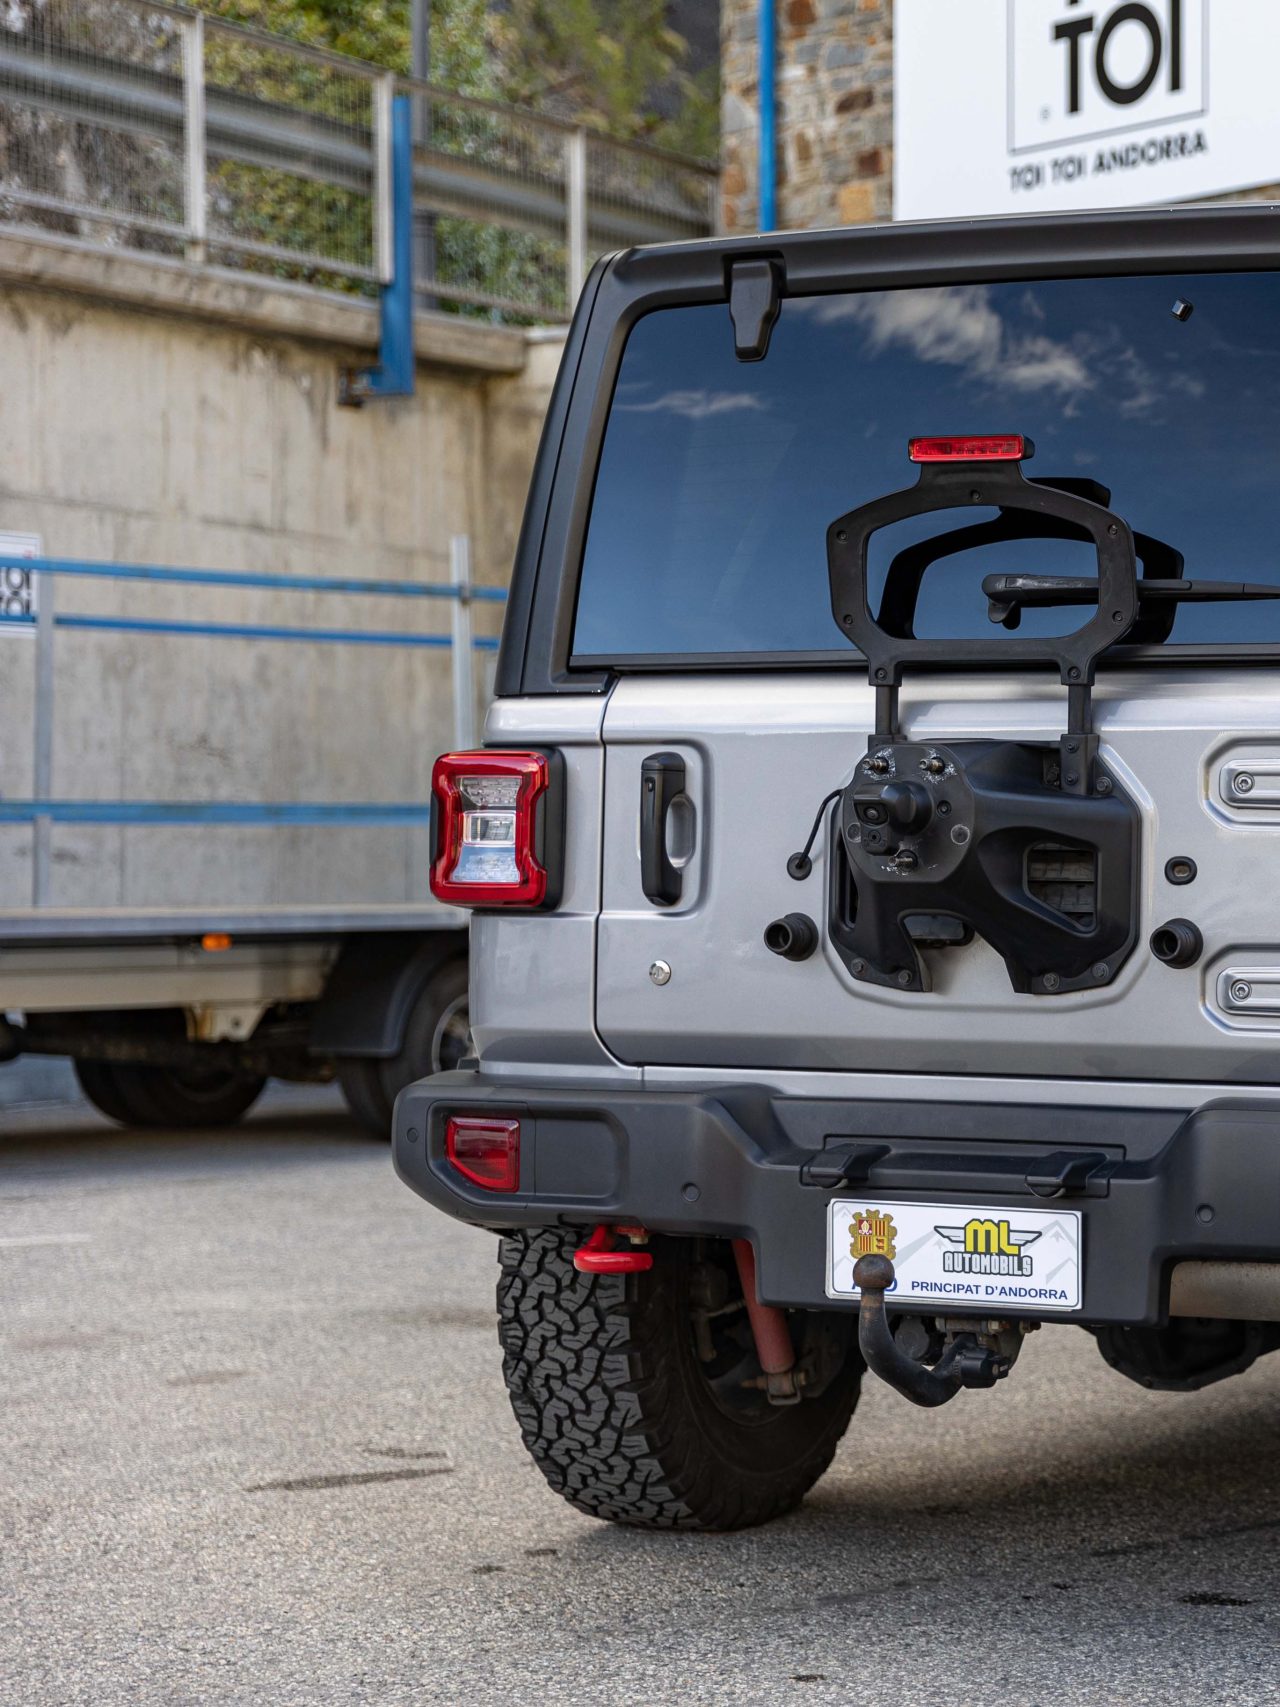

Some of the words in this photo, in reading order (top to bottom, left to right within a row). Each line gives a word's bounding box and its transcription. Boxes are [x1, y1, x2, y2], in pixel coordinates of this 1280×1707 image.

[1053, 0, 1183, 115] TOI
[1010, 162, 1042, 191] TOI
[1051, 155, 1086, 183] TOI
[1093, 131, 1208, 173] ANDORRA
[965, 1218, 1021, 1256] ML
[911, 1280, 981, 1296] PRINCIPAT
[985, 1285, 1068, 1300] D'ANDORRA
